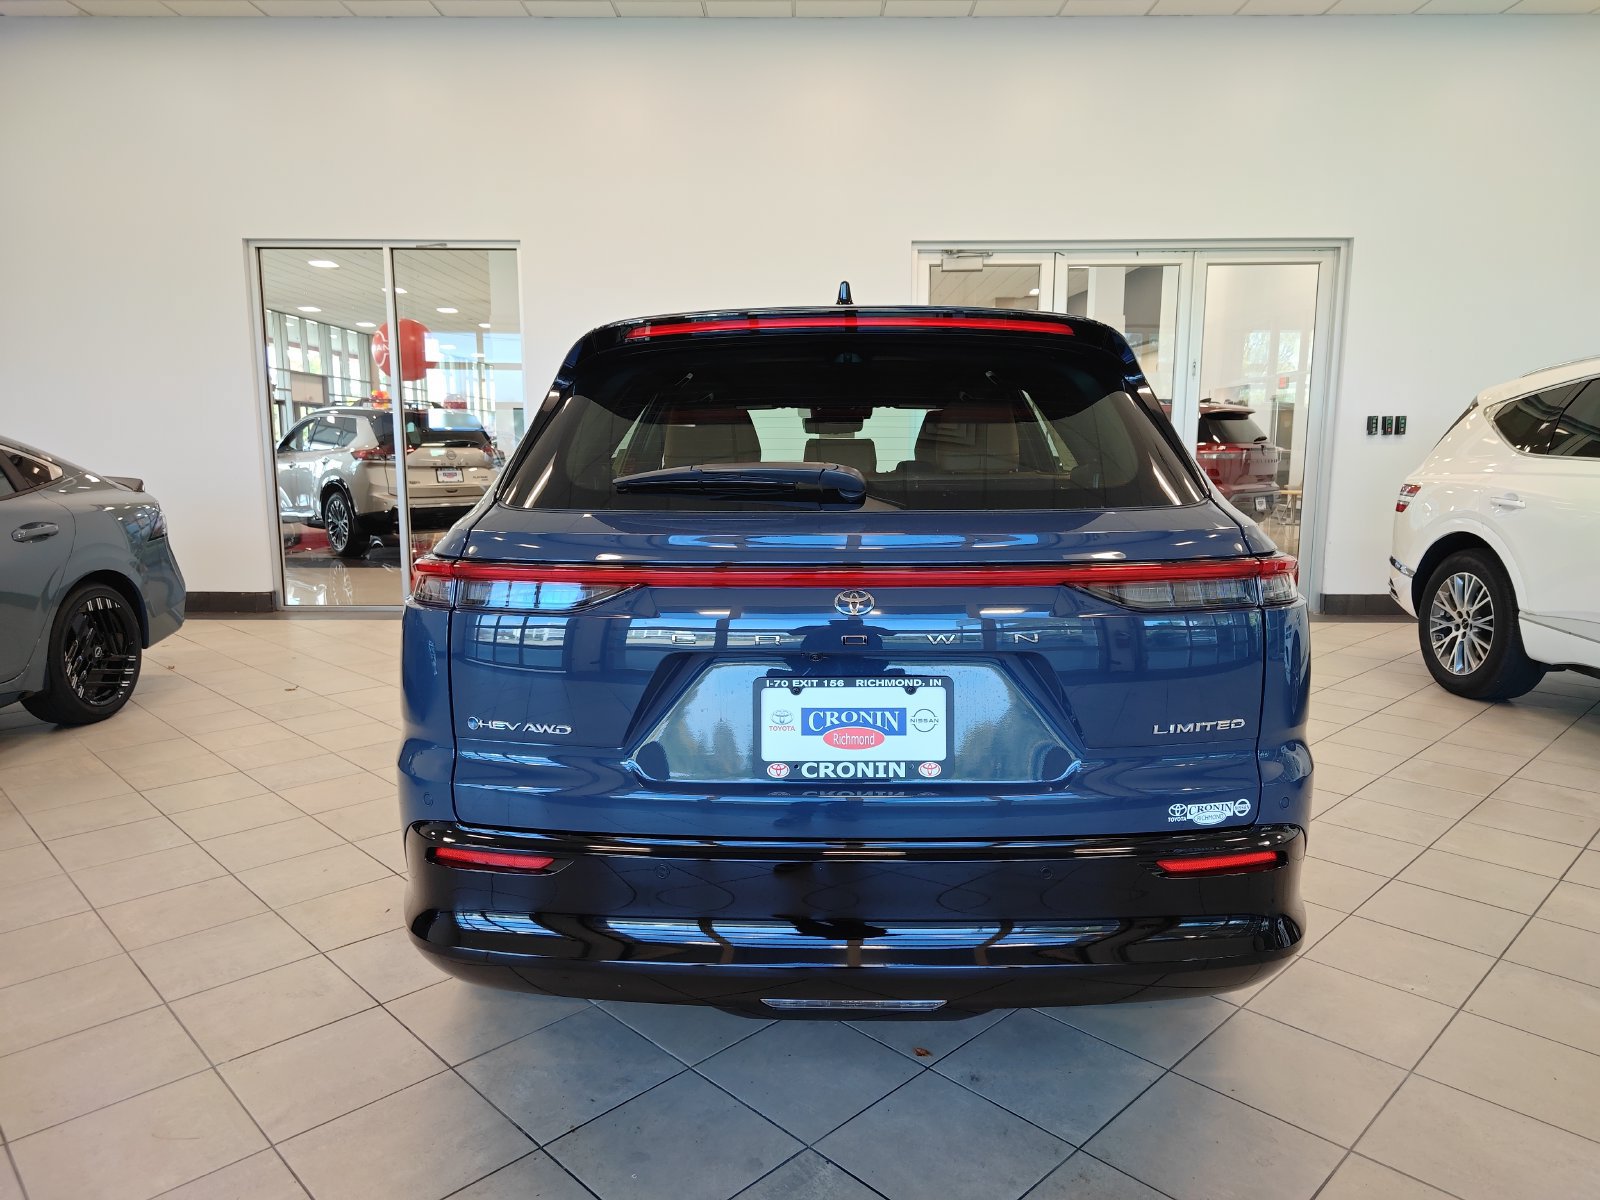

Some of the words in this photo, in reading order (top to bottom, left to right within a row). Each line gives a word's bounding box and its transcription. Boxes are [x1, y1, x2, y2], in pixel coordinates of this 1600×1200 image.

[671, 633, 1039, 646] CROWN
[766, 679, 789, 687] I-70
[792, 679, 818, 687] EXIT
[822, 679, 844, 687] 156
[855, 679, 925, 687] RICHMOND,
[928, 679, 941, 687] IN
[808, 710, 899, 732] CRONIN
[1153, 718, 1246, 735] LIMITED
[522, 723, 572, 735] AWD
[833, 732, 875, 745] Richmond
[801, 762, 905, 778] CRONIN
[1189, 803, 1233, 816] CRONIN
